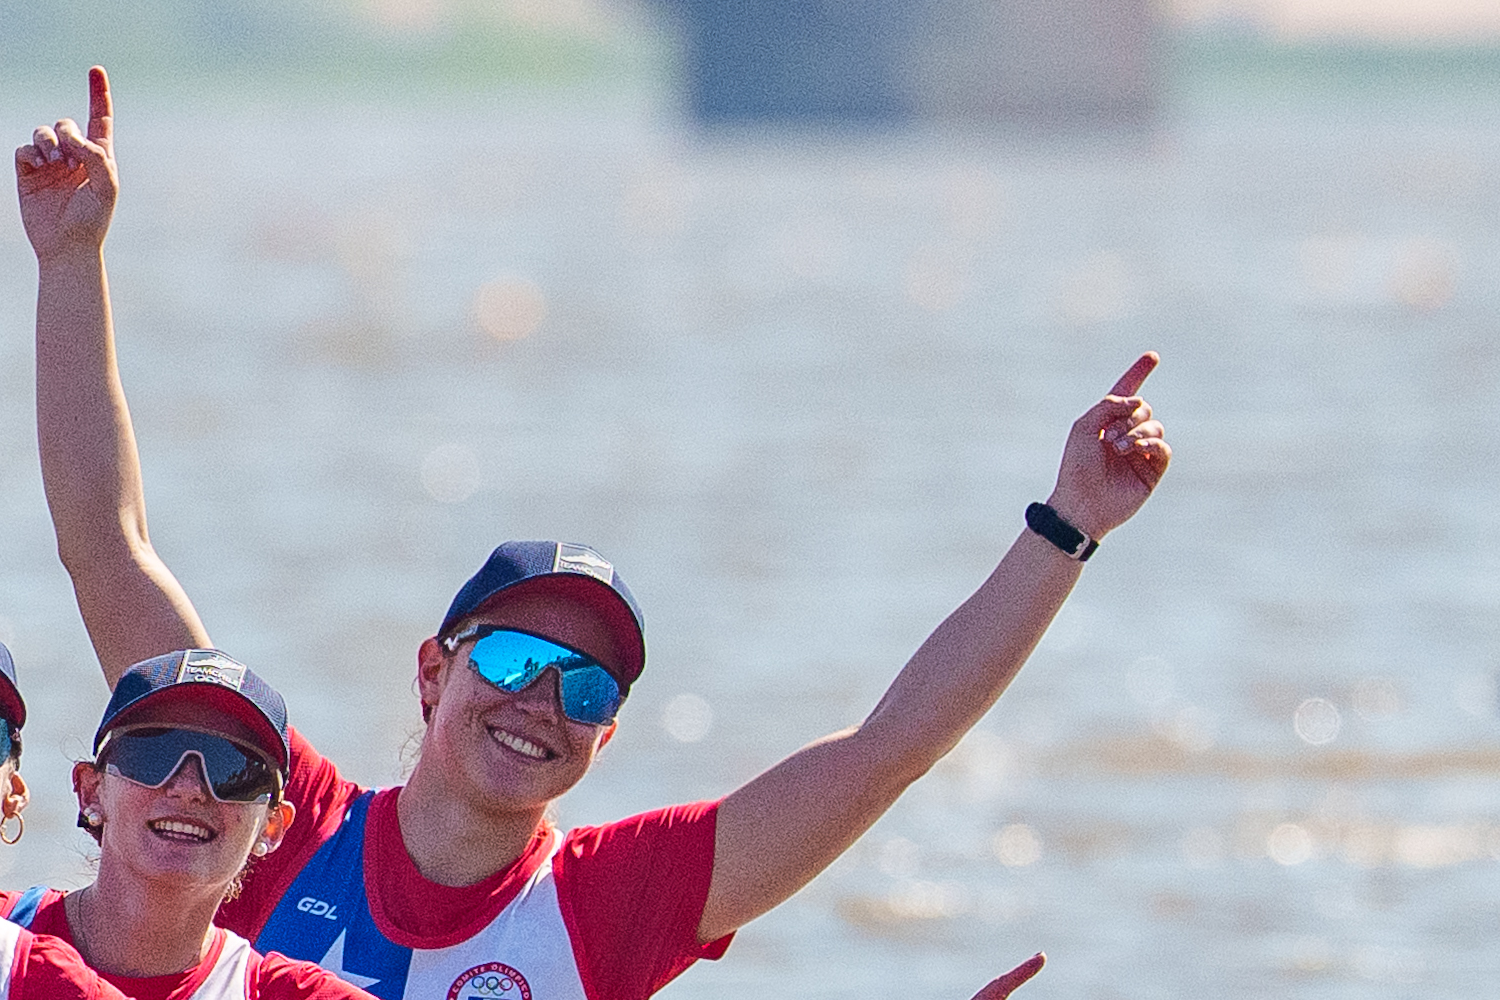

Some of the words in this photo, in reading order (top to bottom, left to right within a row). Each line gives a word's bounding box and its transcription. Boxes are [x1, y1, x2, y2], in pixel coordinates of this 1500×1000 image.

[297, 896, 338, 920] GDL
[452, 965, 485, 993] COMITE
[491, 964, 530, 999] OLIMPICO
